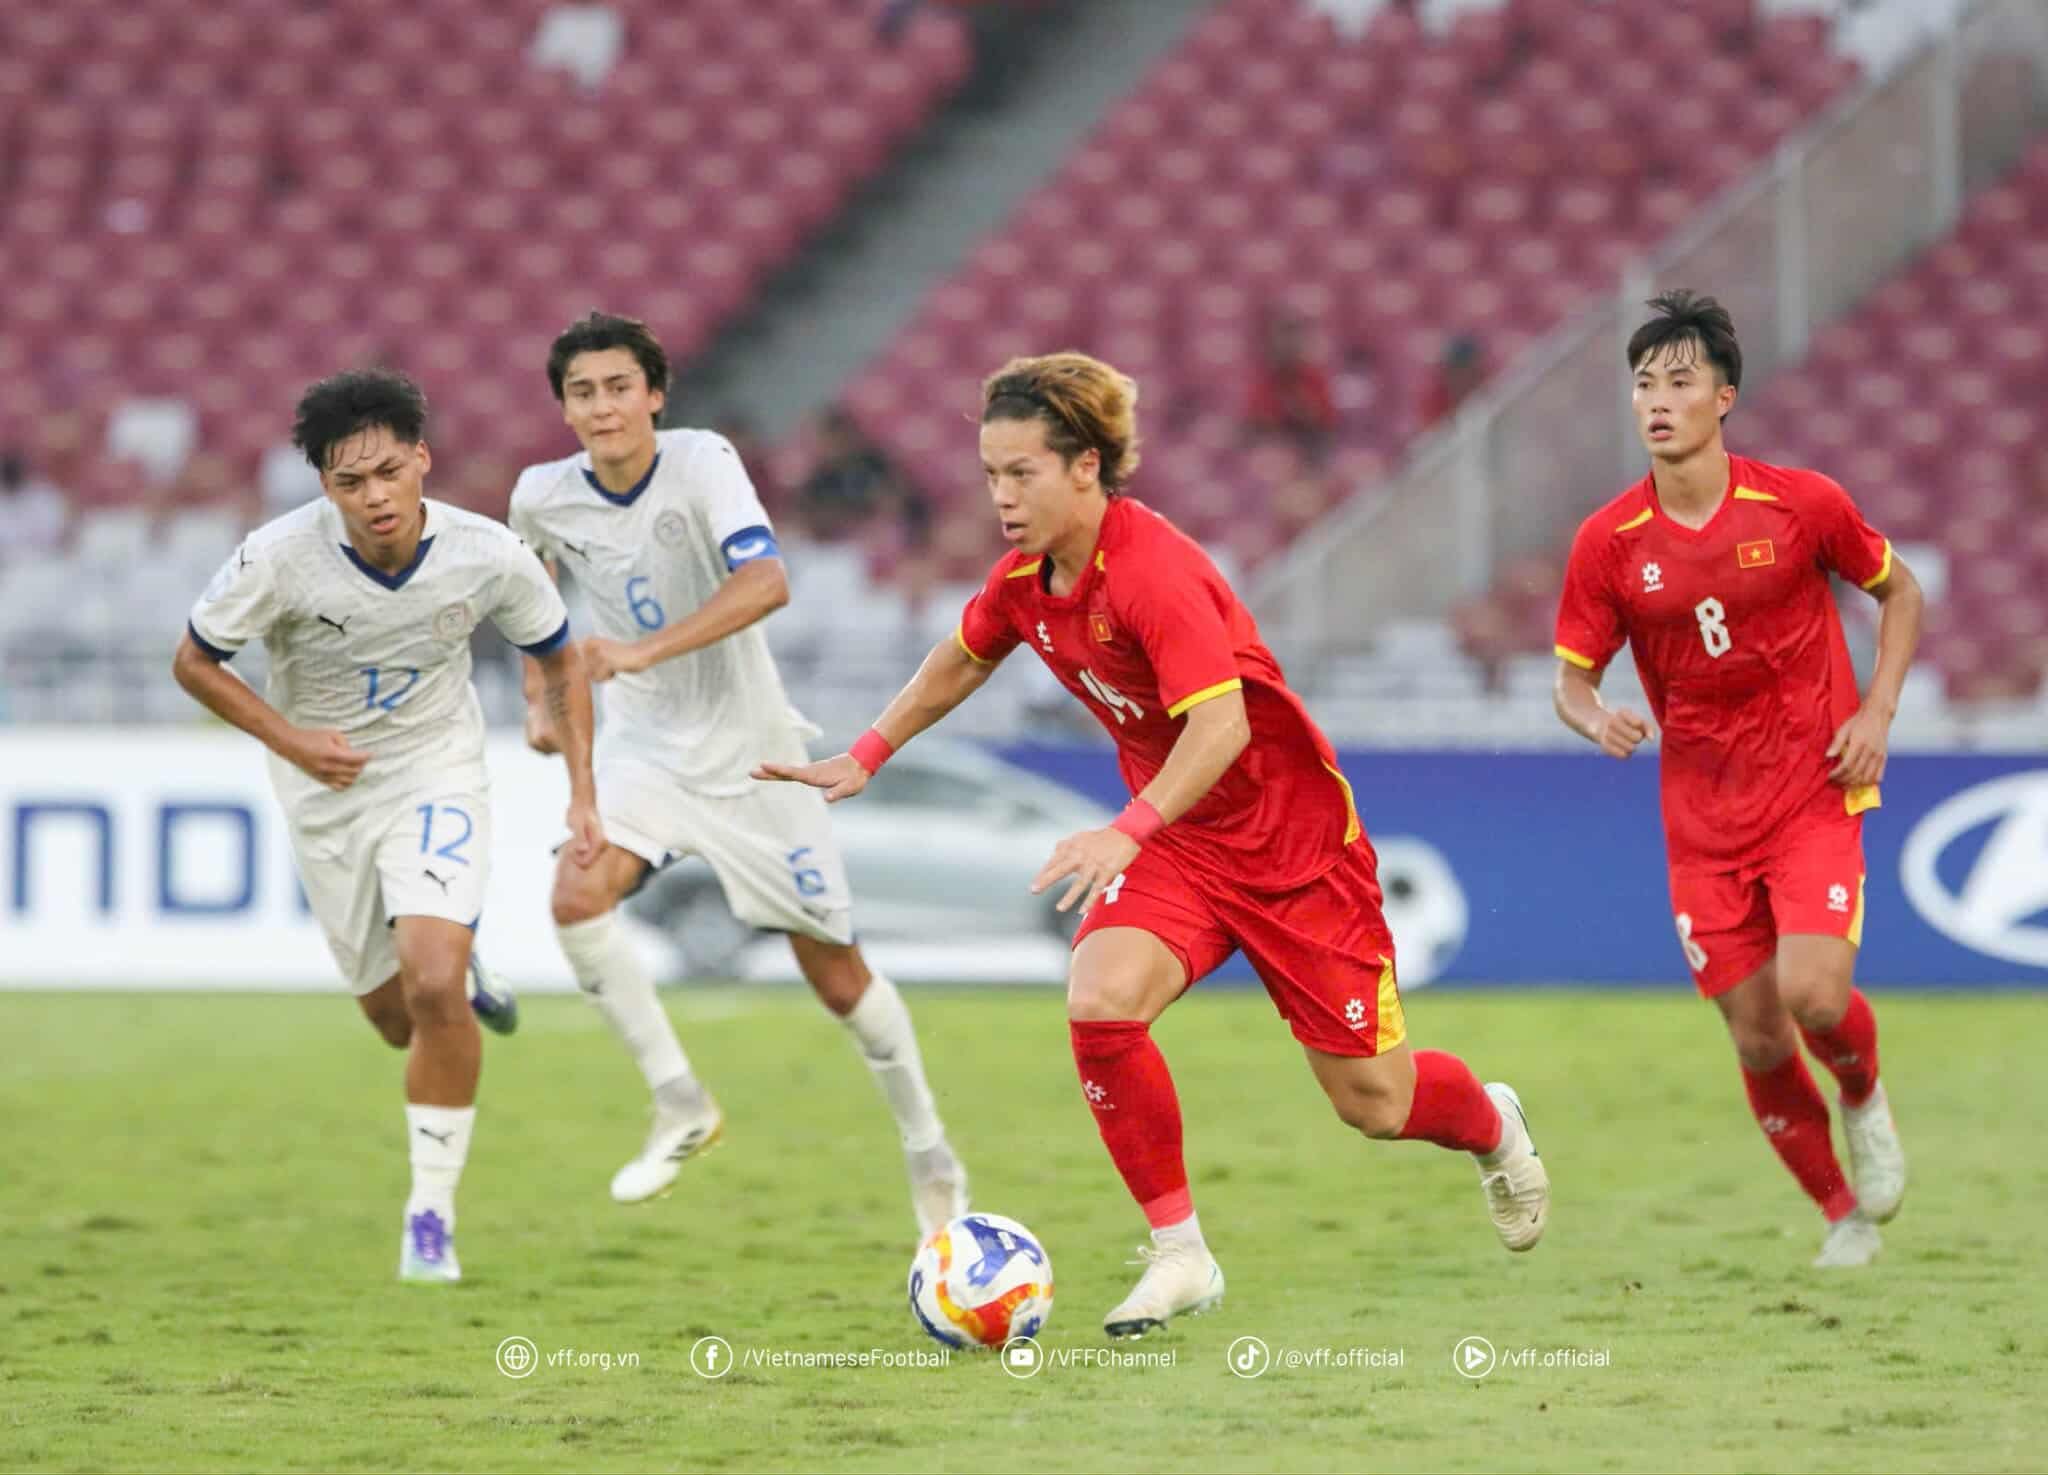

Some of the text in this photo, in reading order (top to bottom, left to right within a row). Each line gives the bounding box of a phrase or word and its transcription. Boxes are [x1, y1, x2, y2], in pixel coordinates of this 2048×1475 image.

[624, 575, 666, 631] 6
[1695, 597, 1732, 658] 8
[359, 667, 420, 711] 12
[416, 803, 473, 866] 12
